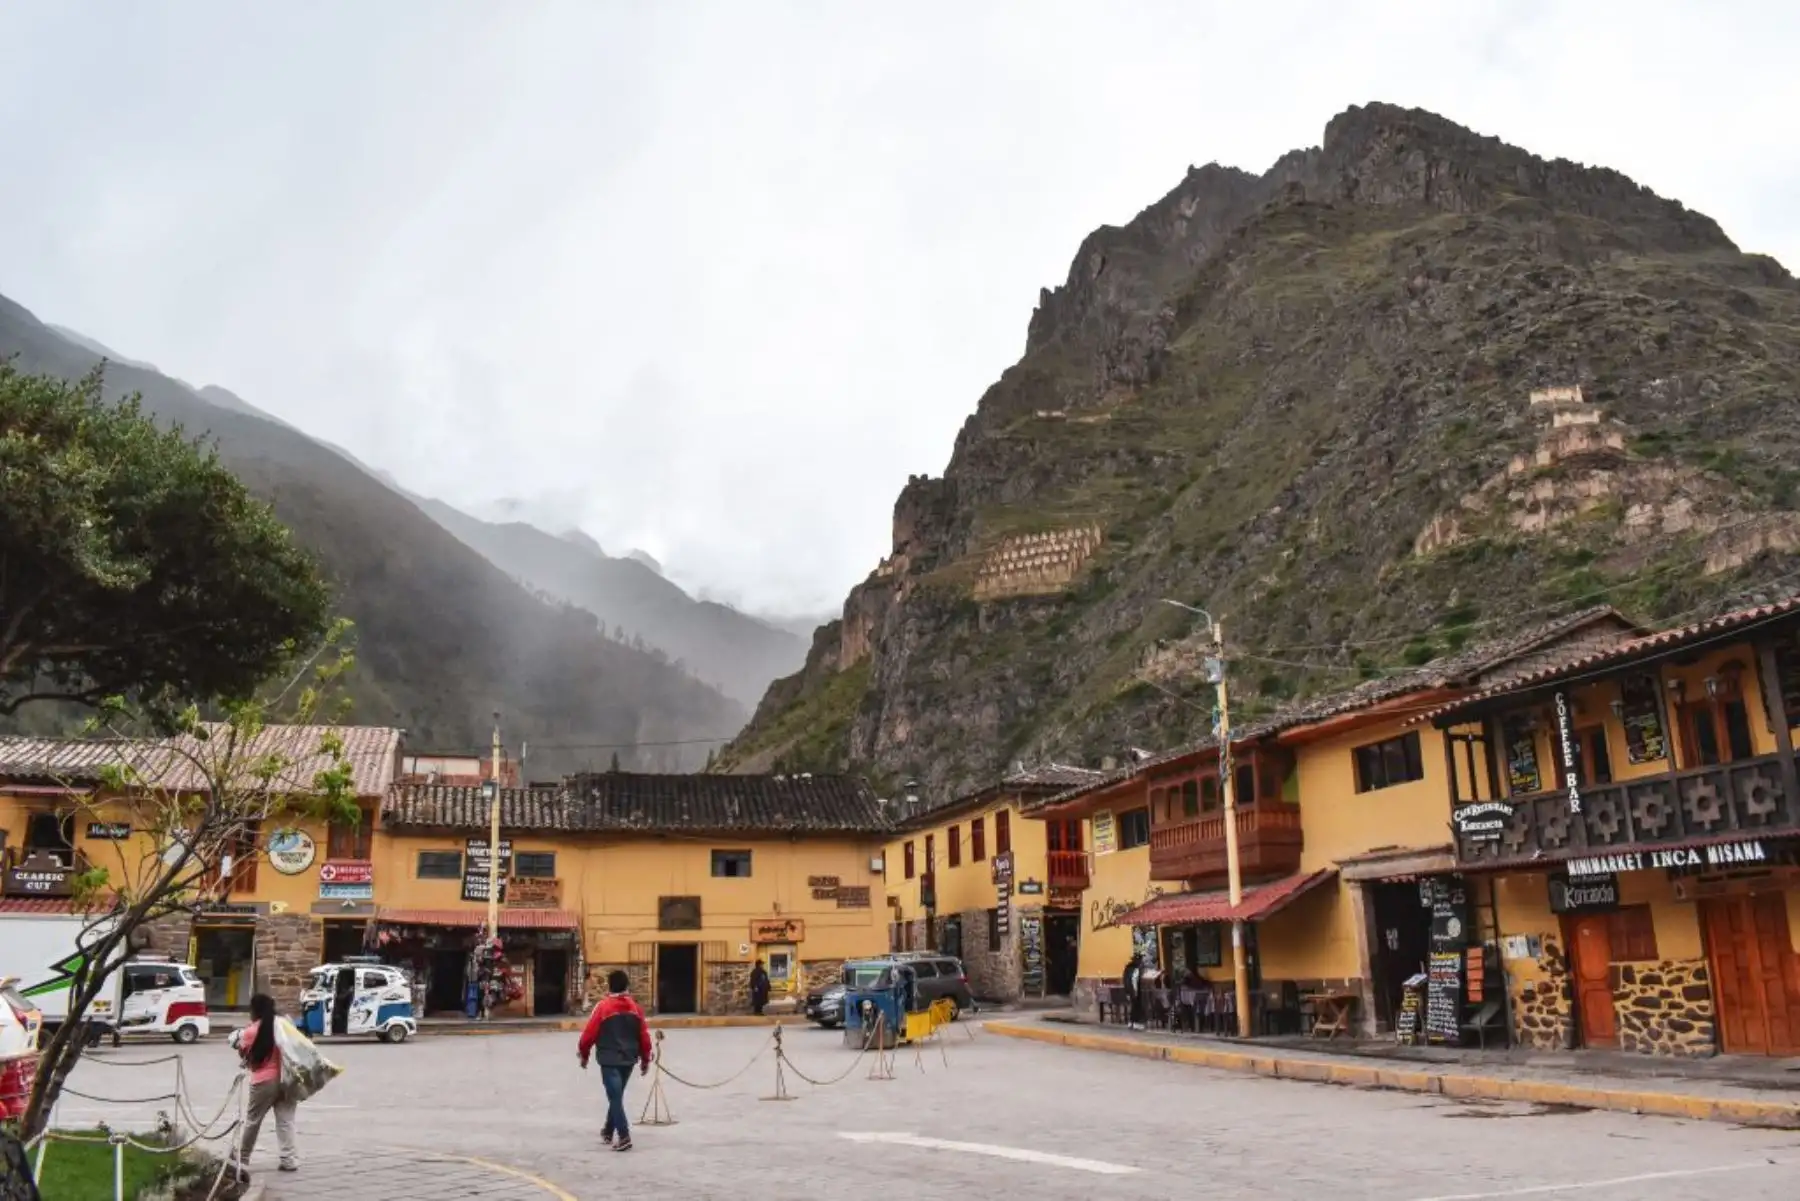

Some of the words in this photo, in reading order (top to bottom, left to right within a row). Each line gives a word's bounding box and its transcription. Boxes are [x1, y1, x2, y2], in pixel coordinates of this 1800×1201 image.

[1555, 692, 1573, 767] COFFEE
[1566, 773, 1581, 813] BAR
[1567, 852, 1643, 876] MINIMARKET
[1651, 850, 1702, 868] INCA
[1707, 841, 1766, 864] MISANA
[15, 872, 65, 881] CLASSIC
[26, 882, 52, 890] CUY
[1564, 884, 1614, 908] Koricancha
